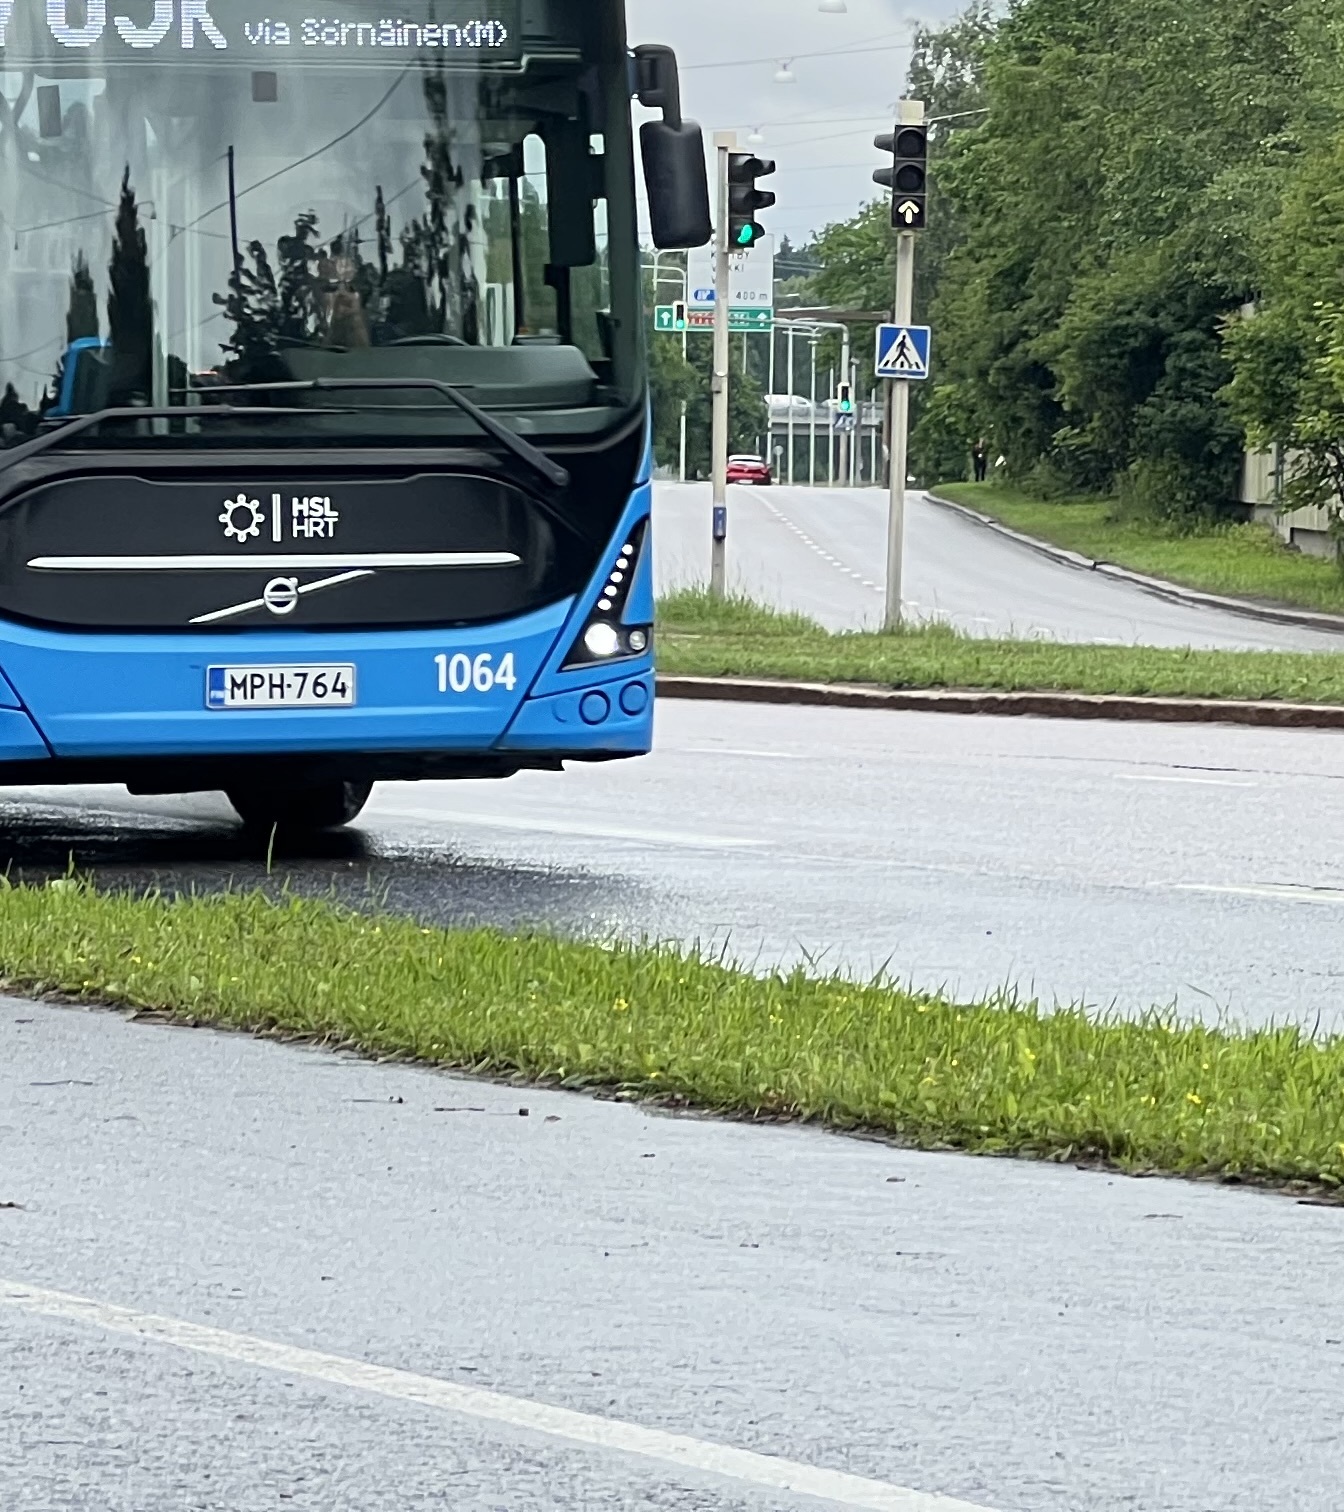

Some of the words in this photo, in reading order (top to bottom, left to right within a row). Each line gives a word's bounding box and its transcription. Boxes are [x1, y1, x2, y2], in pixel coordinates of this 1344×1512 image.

[244, 18, 291, 46] via
[300, 18, 508, 47] Sörnäinen(M)
[291, 496, 339, 518] HSL
[291, 517, 339, 538] HRT
[229, 671, 349, 701] MPH-764
[433, 652, 518, 693] 1064
